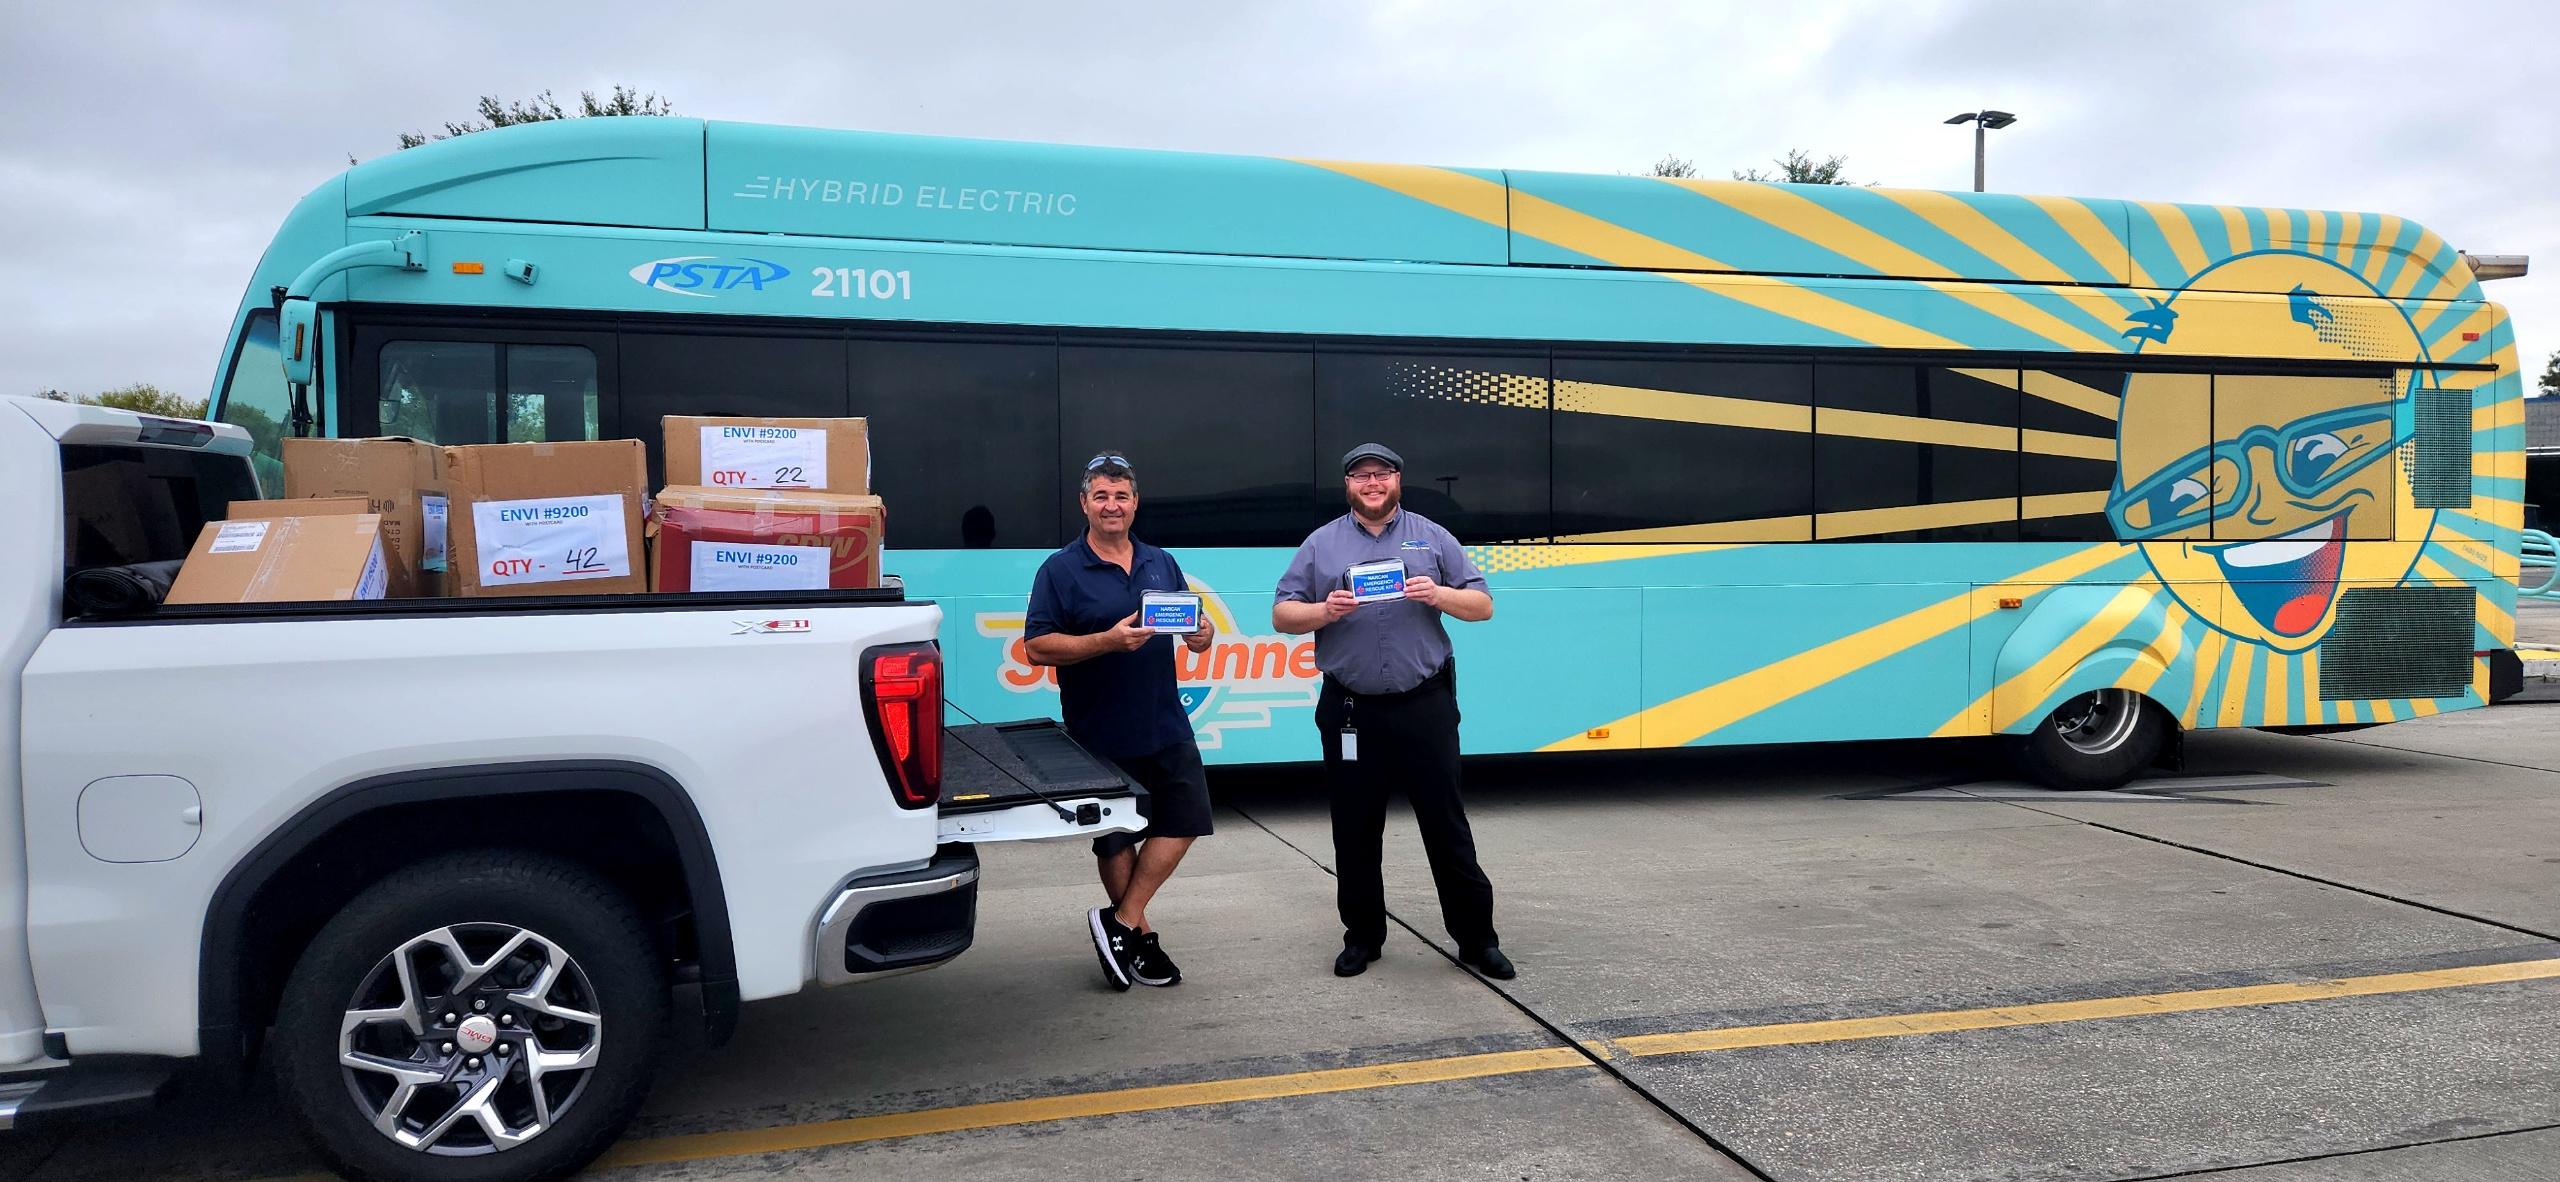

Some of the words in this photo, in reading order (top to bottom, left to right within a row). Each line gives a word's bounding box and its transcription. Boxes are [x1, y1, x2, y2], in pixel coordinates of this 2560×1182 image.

[773, 176, 903, 206] HYBRID
[916, 185, 1077, 216] ELECTRIC
[646, 262, 764, 291] PSTA
[811, 266, 911, 300] 21101
[723, 427, 755, 438] ENVI
[759, 428, 797, 439] #9200
[713, 471, 746, 486] QTY
[775, 466, 807, 484] 22
[500, 507, 539, 522] ENVI
[543, 505, 589, 520] #9200
[492, 558, 532, 577] QTY
[566, 547, 605, 571] 42
[716, 550, 751, 563] ENVI
[755, 552, 798, 566] #9200
[1363, 579, 1394, 587] EMERGENCY
[1367, 573, 1389, 581] NARCAN
[461, 1027, 492, 1043] GMC
